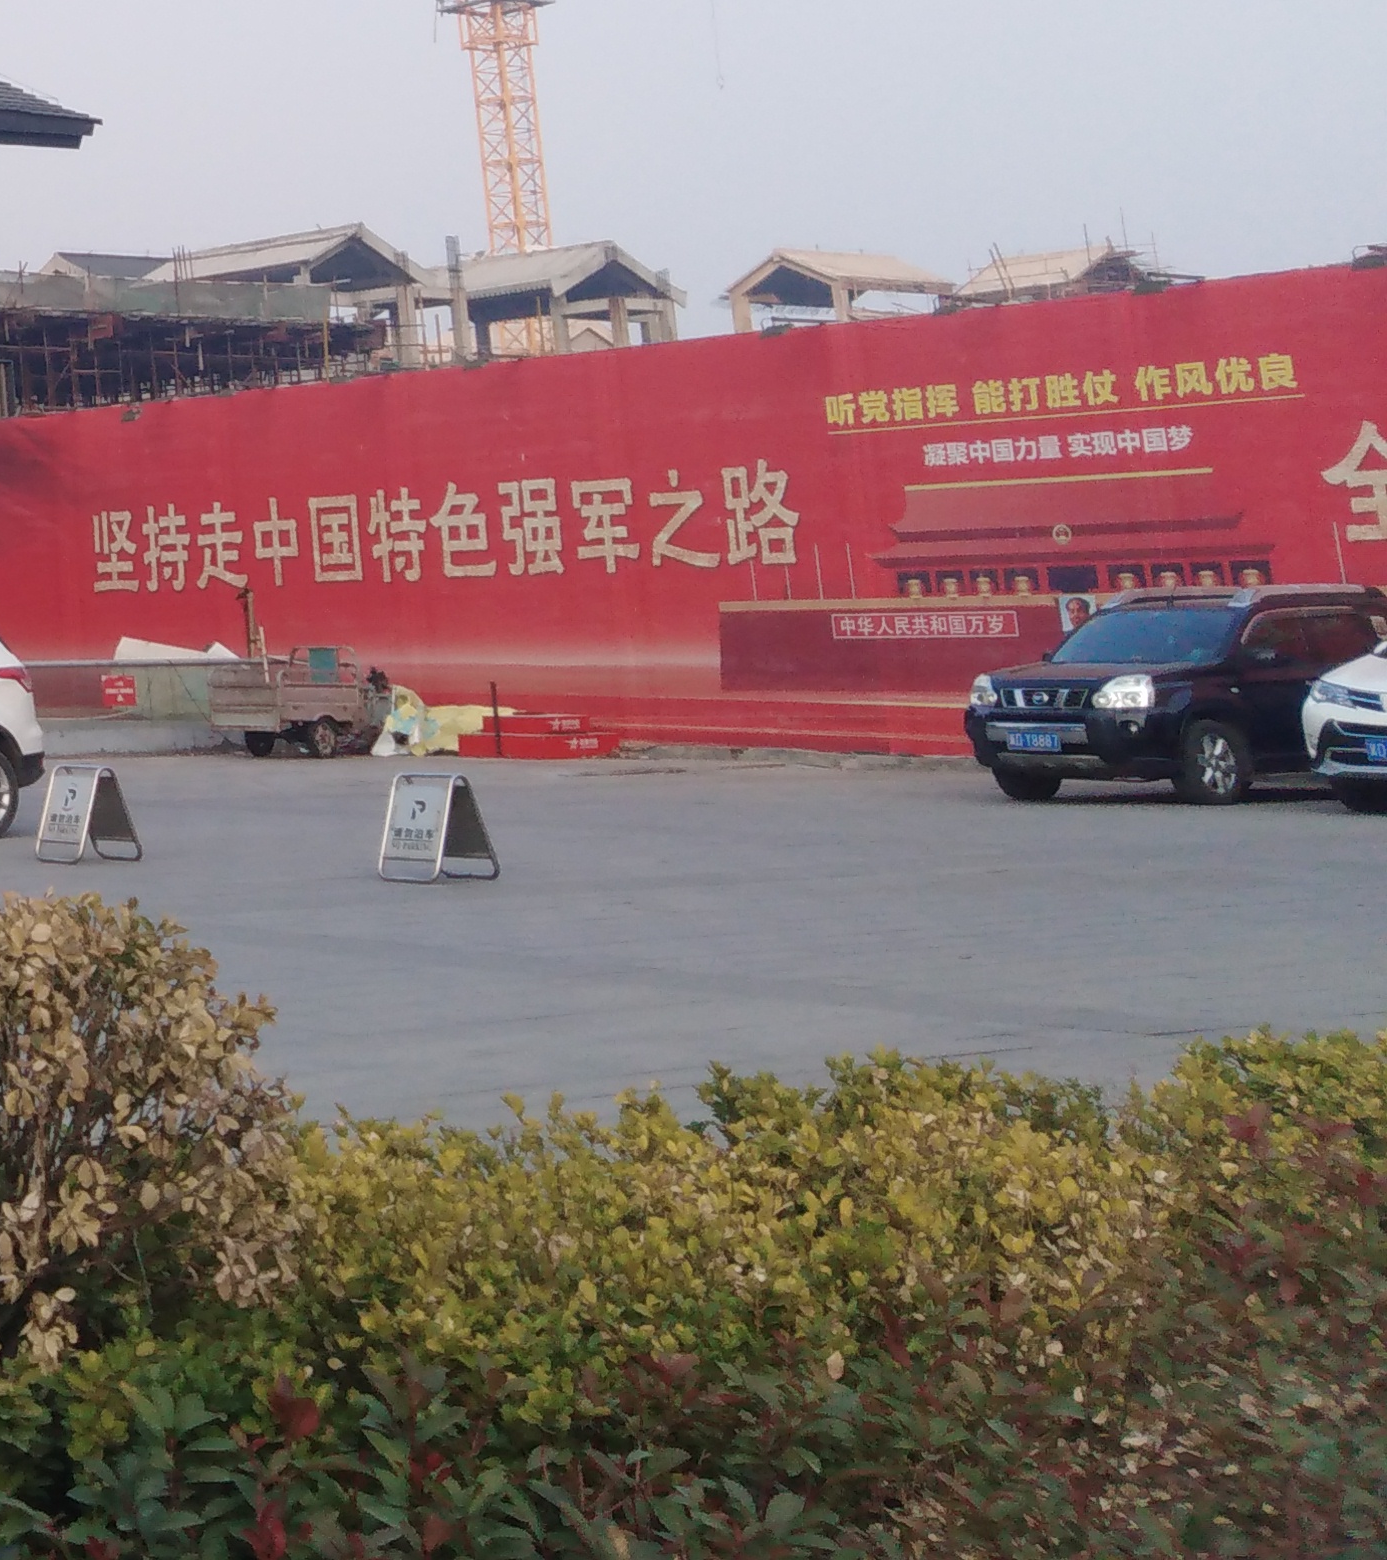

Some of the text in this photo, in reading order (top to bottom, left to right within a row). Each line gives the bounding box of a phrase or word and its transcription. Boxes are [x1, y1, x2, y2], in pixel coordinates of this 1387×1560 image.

[825, 353, 1299, 426] 听党指挥 能打胜仗 作风优良
[923, 424, 1194, 467] 凝聚中国力量 实现中国梦
[91, 458, 800, 593] 坚持走中国特色强军之路
[840, 613, 1005, 636] 中华人民共和国万岁
